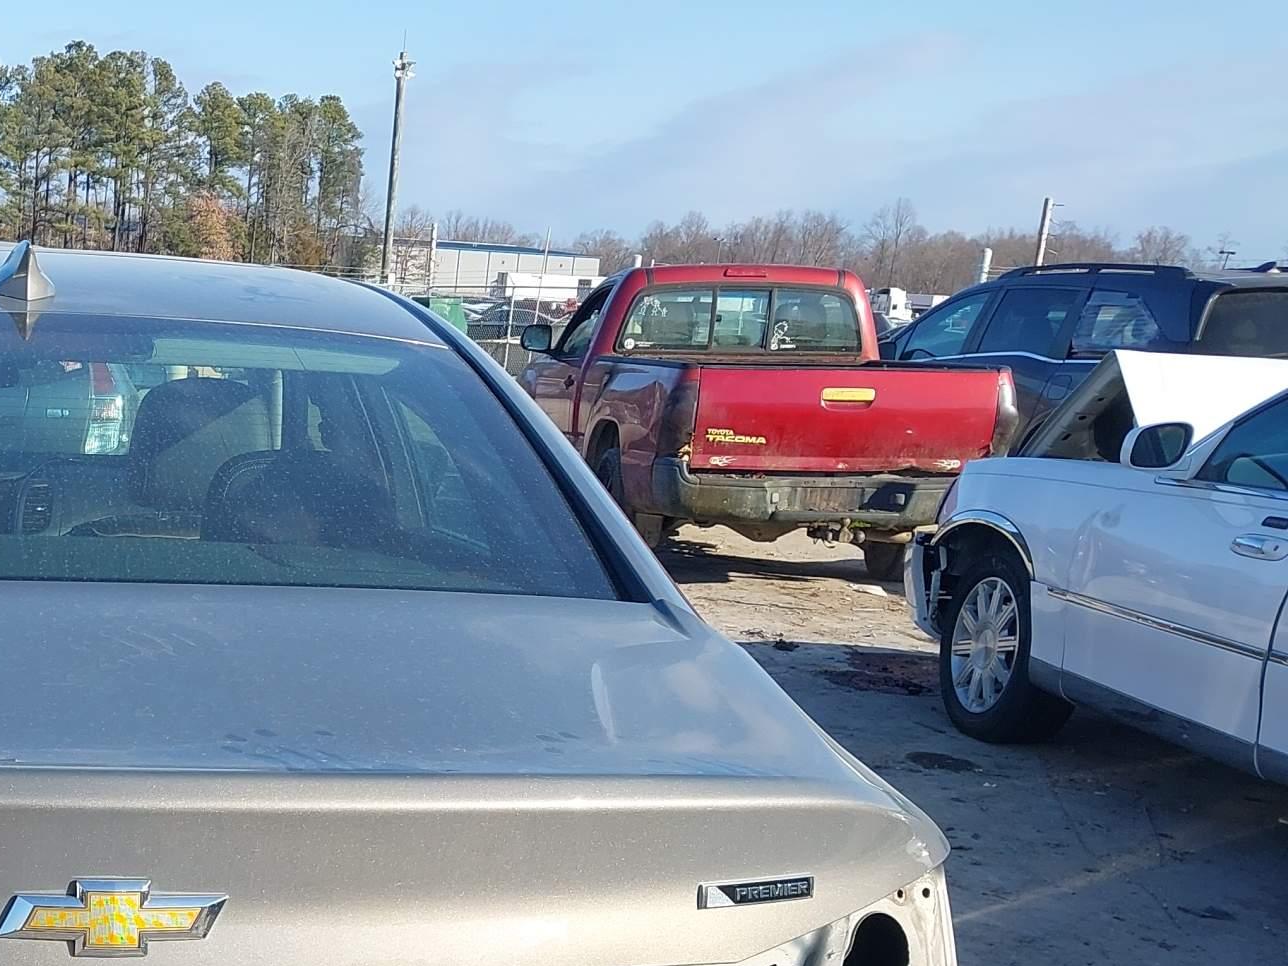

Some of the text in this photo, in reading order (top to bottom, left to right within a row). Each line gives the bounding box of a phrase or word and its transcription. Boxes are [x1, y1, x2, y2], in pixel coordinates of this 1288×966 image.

[706, 428, 735, 436] TOYOTA
[705, 434, 767, 445] TACOMA
[736, 881, 810, 901] PREMIER
